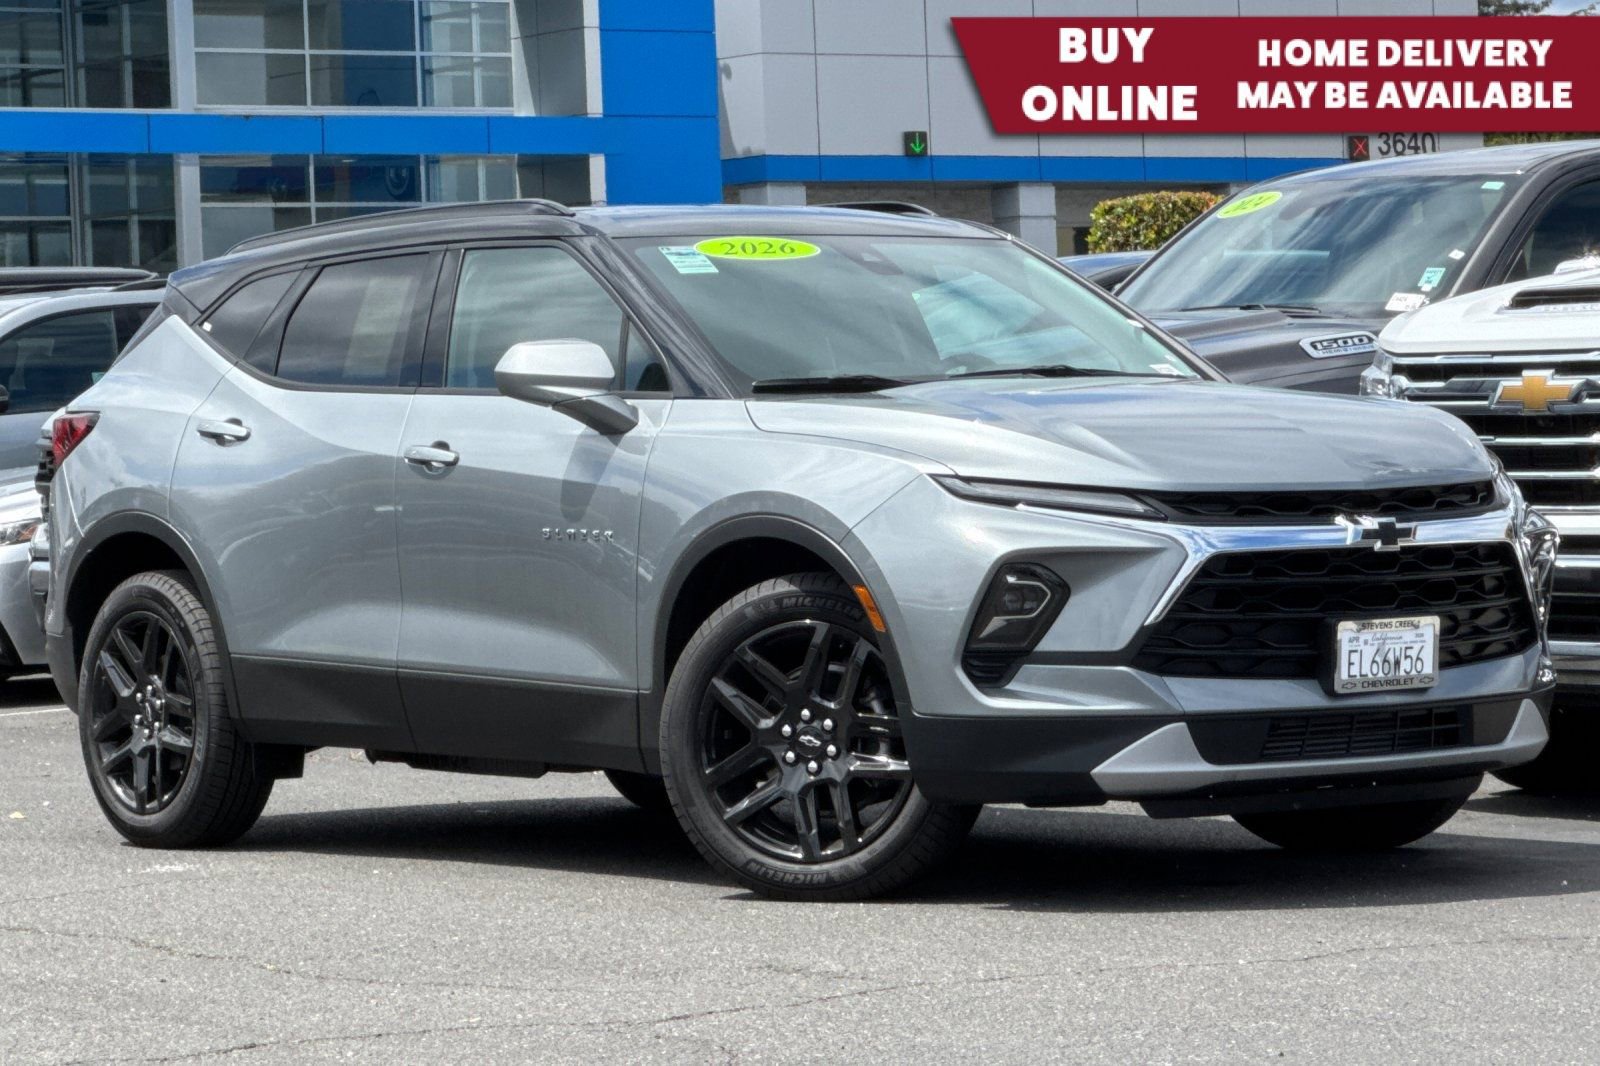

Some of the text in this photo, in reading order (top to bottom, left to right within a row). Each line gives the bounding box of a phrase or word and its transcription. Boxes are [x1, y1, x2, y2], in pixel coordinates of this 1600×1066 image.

[1377, 131, 1437, 157] 3640
[719, 241, 796, 256] 2026
[1311, 335, 1370, 351] 1500
[1361, 621, 1393, 631] STEVENS
[1347, 645, 1425, 678] EL66W56
[1361, 677, 1414, 689] CHEVROLET
